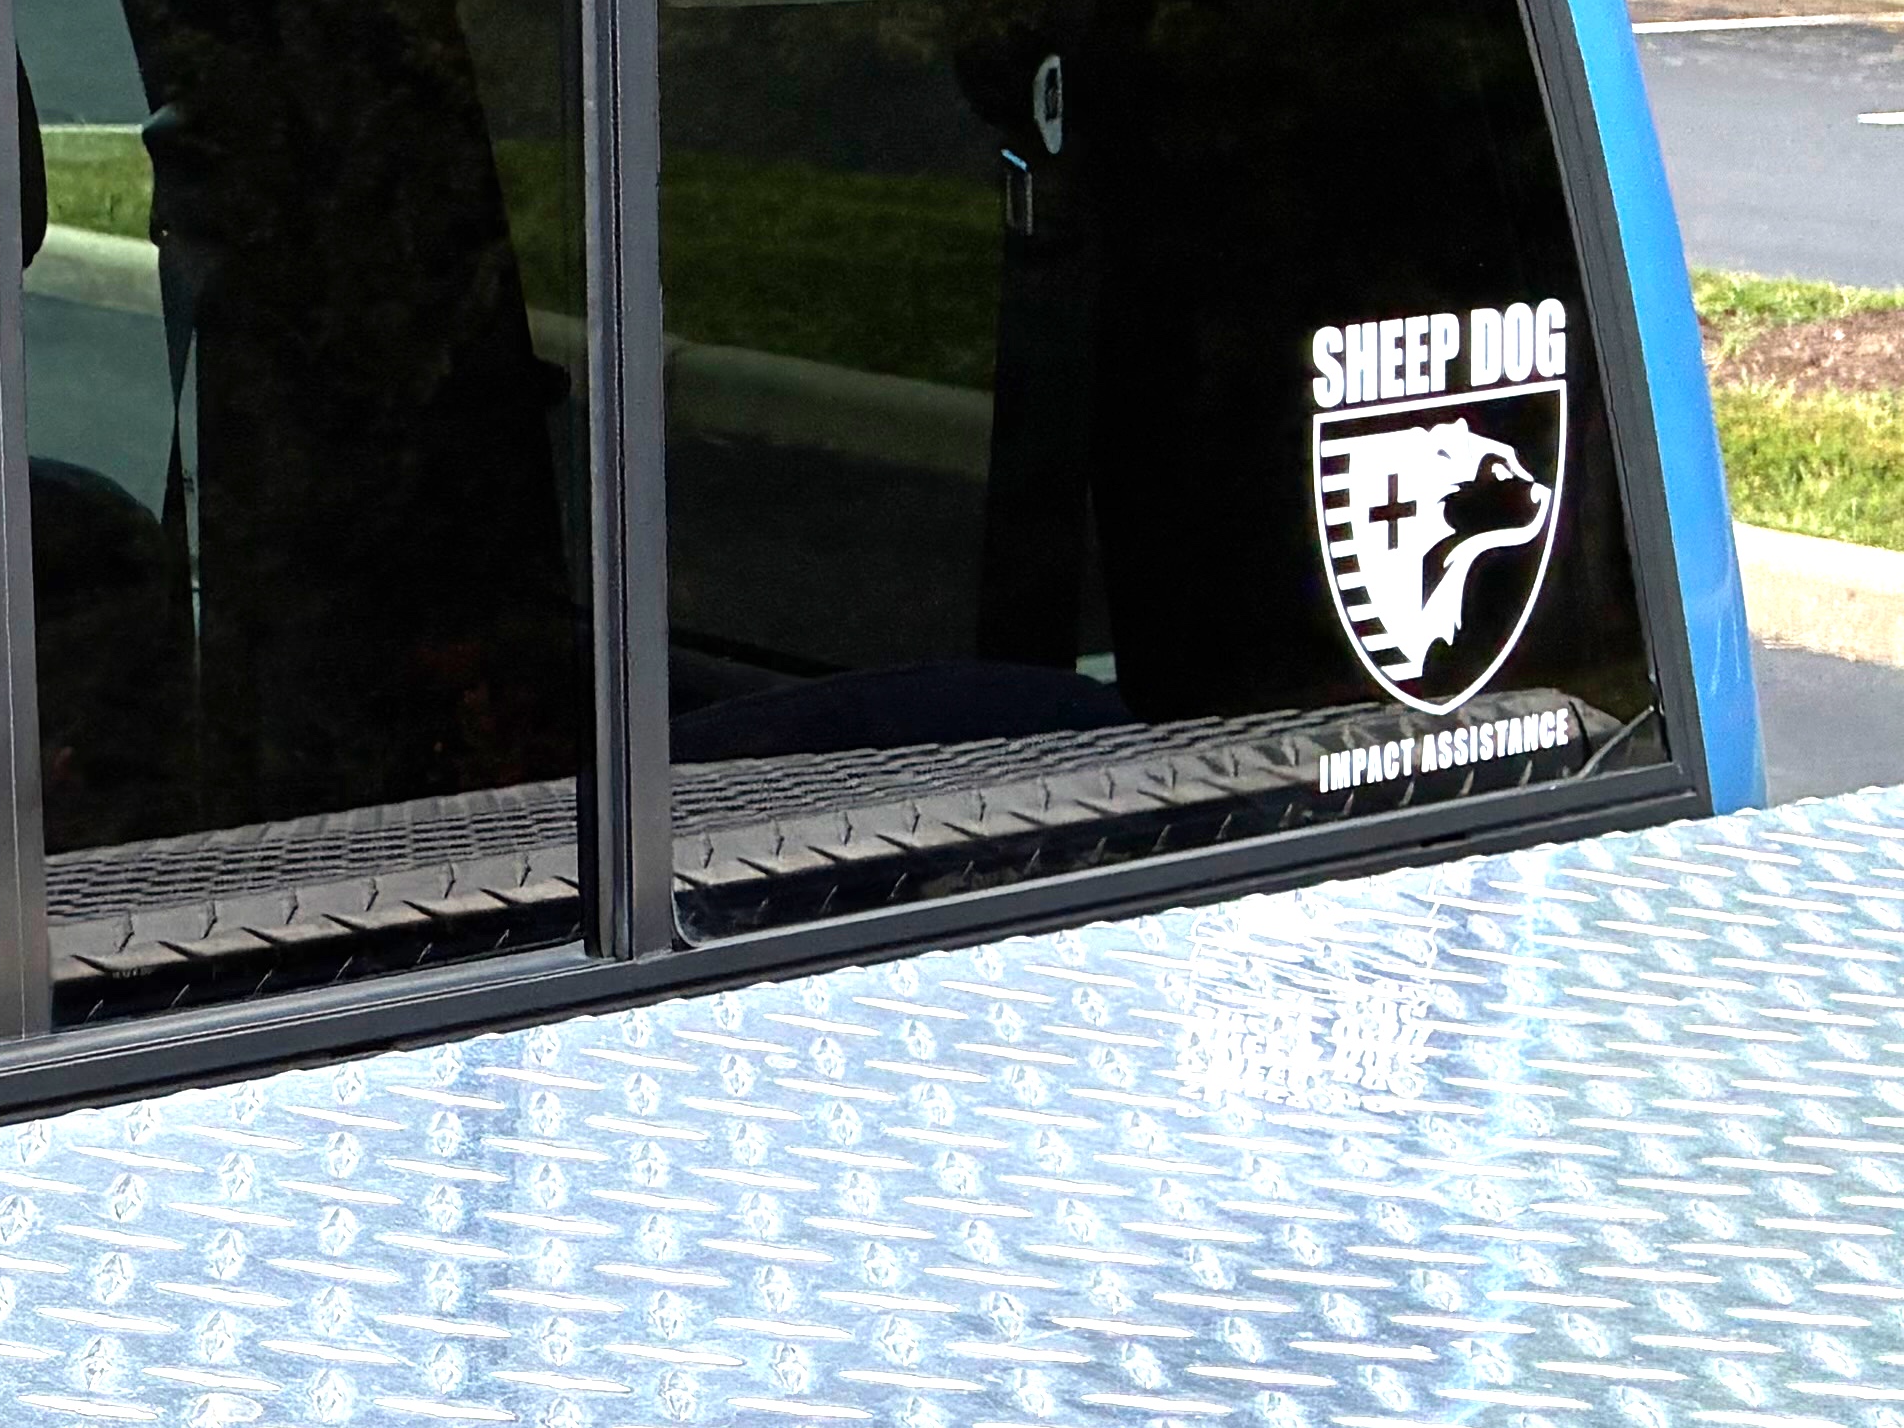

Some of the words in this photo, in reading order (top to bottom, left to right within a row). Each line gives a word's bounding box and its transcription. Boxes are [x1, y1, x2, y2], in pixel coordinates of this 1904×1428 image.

[1312, 313, 1460, 408] SHEEP
[1470, 298, 1566, 388] DOG
[1319, 737, 1417, 794] IMPACT
[1421, 708, 1569, 774] ASSISTANCE
